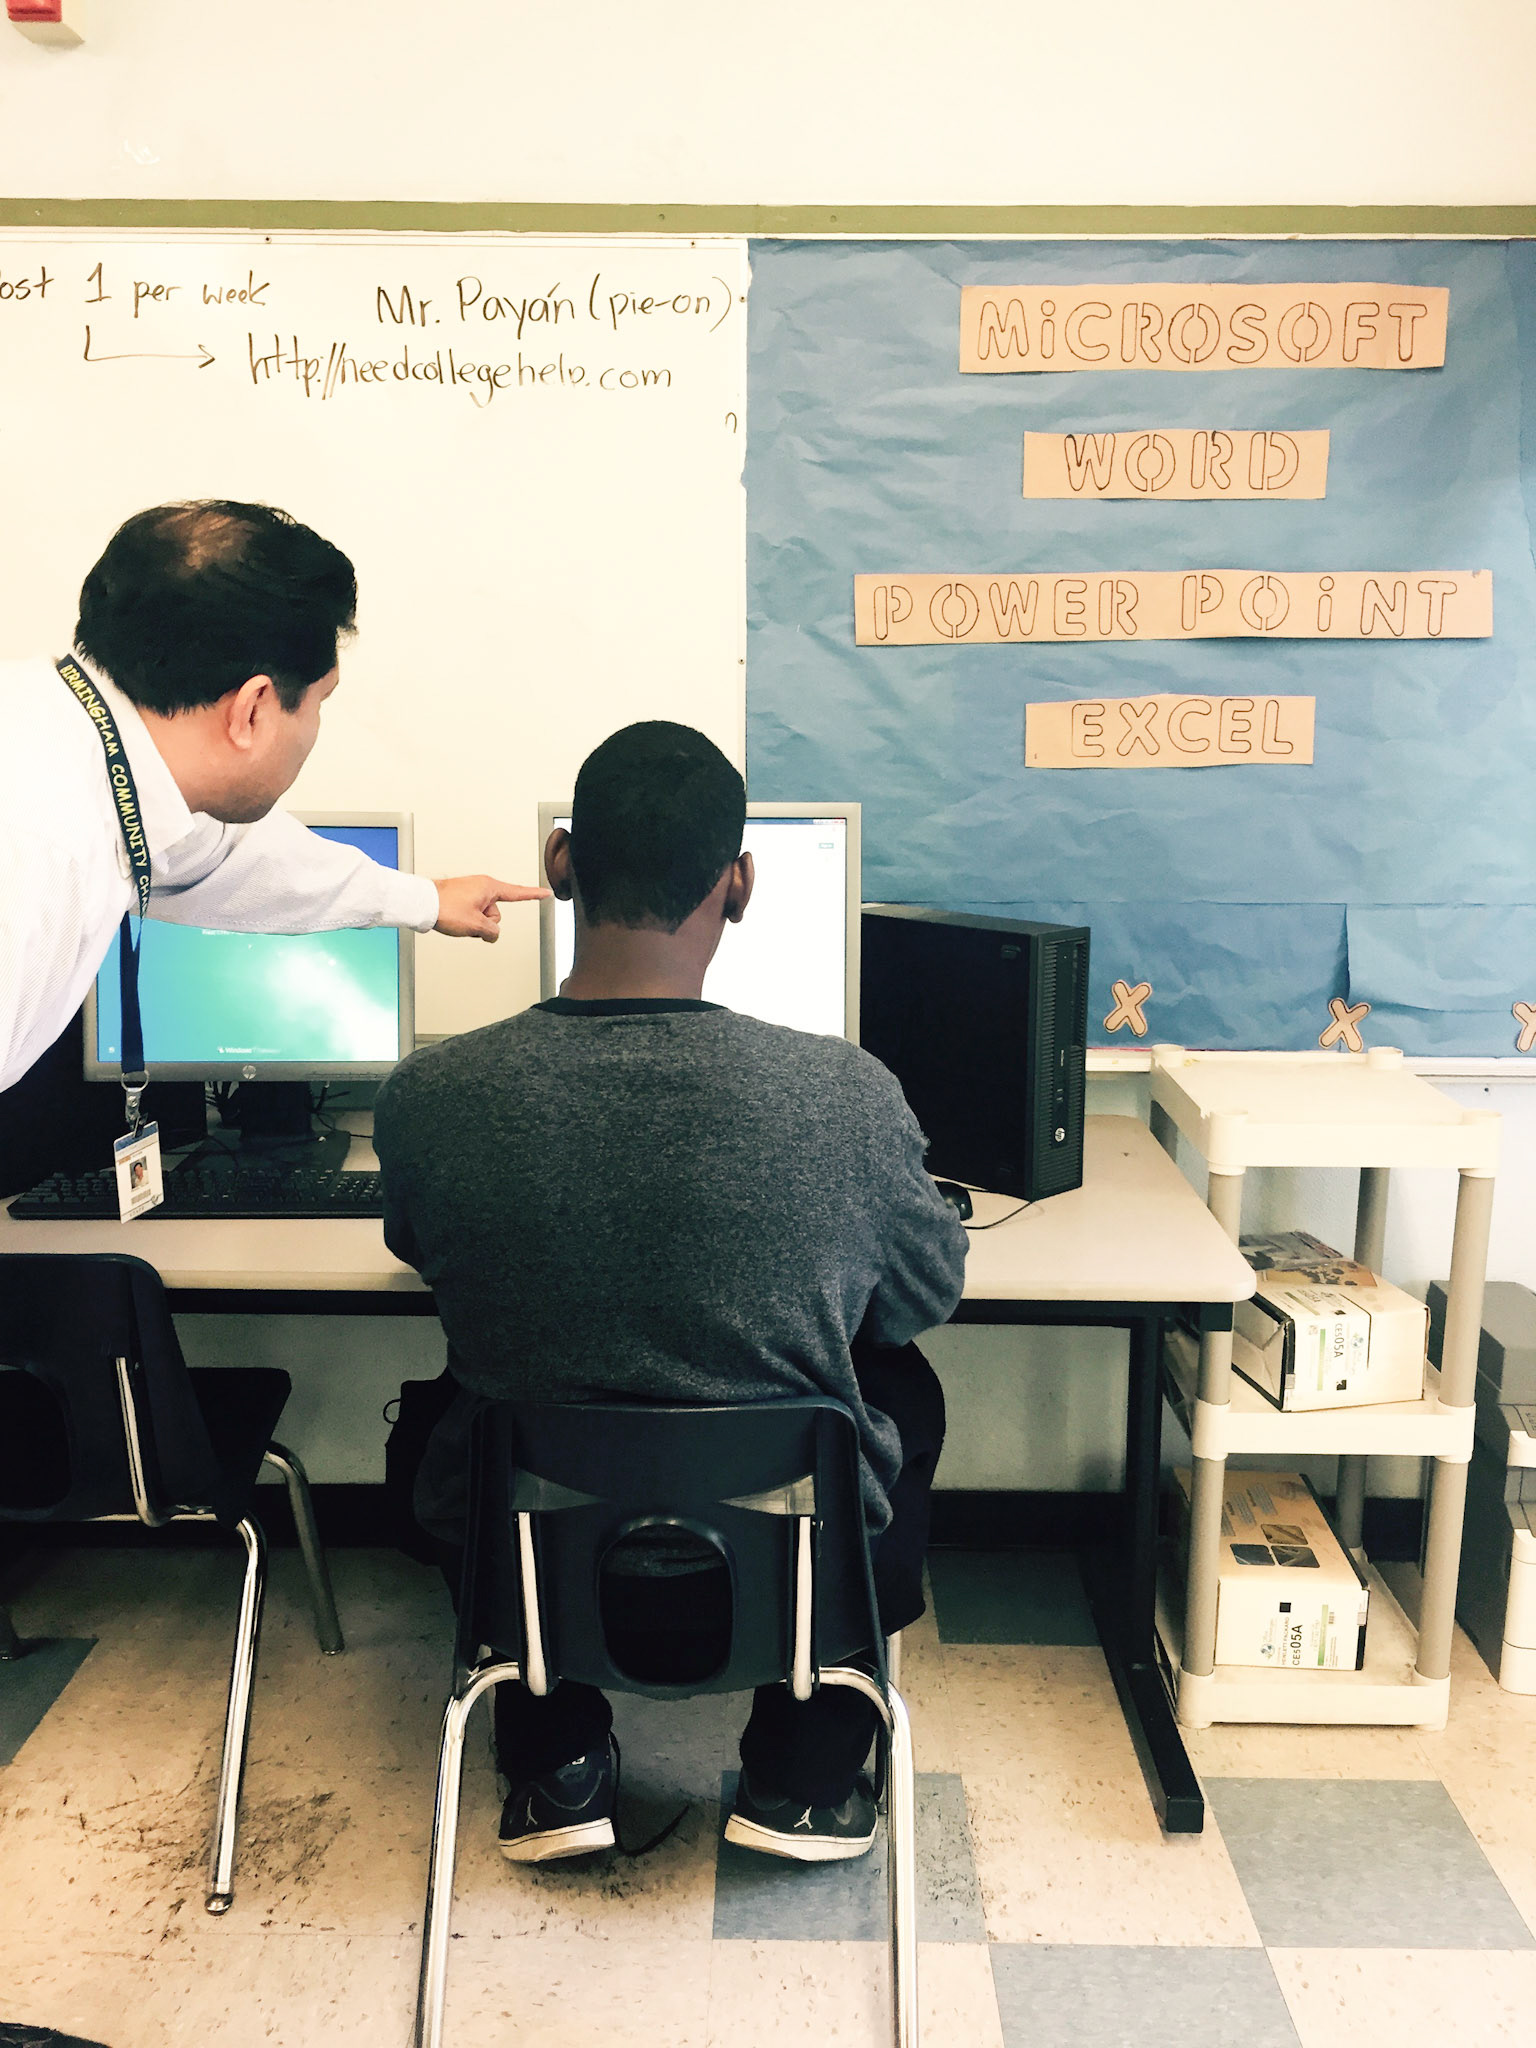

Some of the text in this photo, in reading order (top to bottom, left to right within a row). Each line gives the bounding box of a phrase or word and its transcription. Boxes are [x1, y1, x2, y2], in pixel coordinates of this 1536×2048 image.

[0, 262, 270, 318] ost 1 per week
[377, 273, 731, 340] Mr. Payán (pie-on)
[1064, 432, 1299, 492] WORD
[874, 579, 1139, 641] POWER
[1072, 699, 1294, 757] EXCEL
[59, 663, 120, 758] BIRMINGHAM
[111, 763, 148, 868] COMMUNITY
[1290, 1623, 1303, 1666] CE505A
